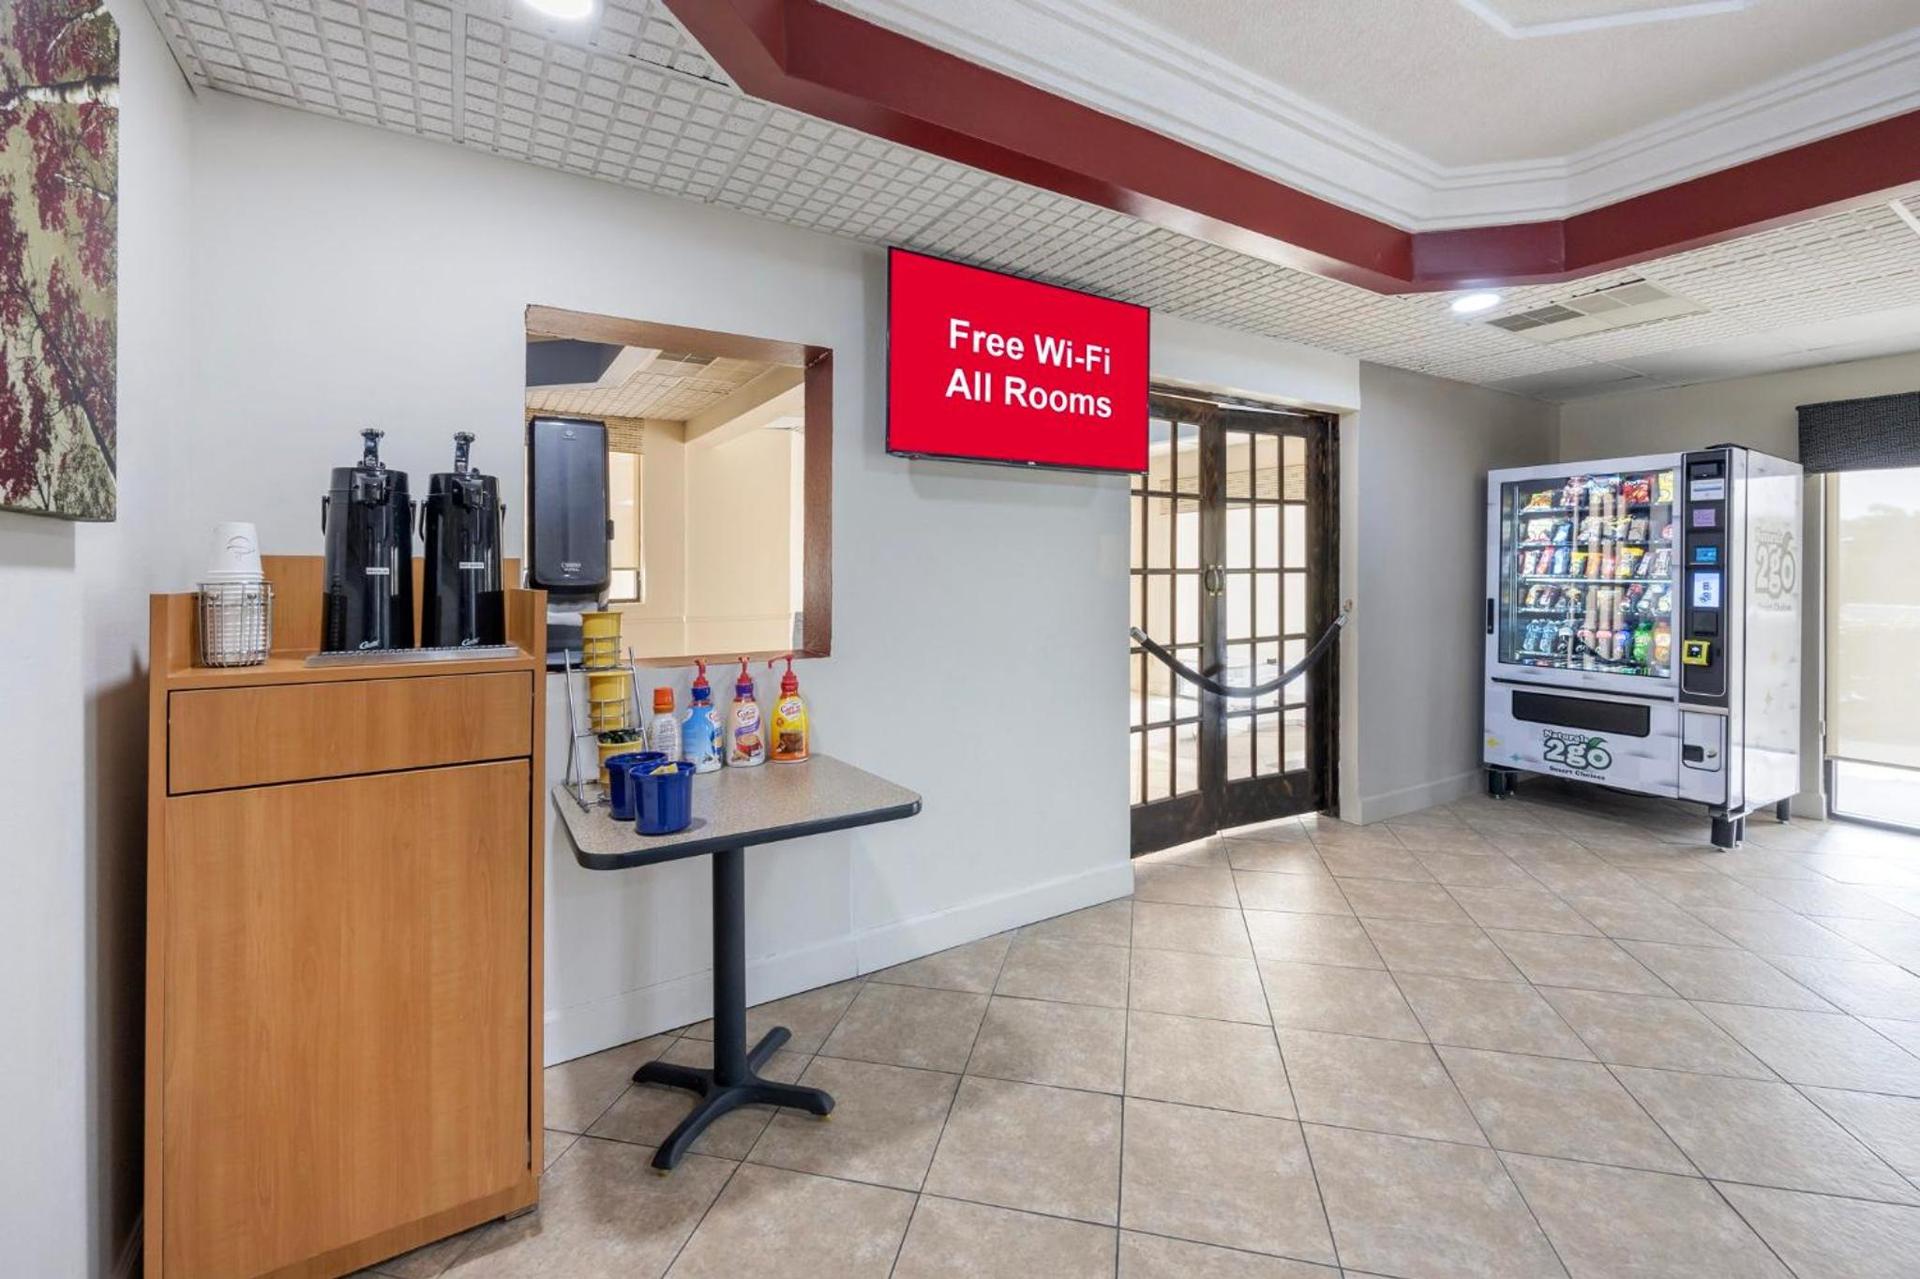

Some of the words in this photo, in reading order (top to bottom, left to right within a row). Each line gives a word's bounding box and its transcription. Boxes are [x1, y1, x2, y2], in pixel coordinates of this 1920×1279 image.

[949, 318, 1025, 361] Free
[1034, 334, 1111, 375] Wi-Fi
[945, 368, 992, 403] All
[1004, 376, 1112, 418] Rooms
